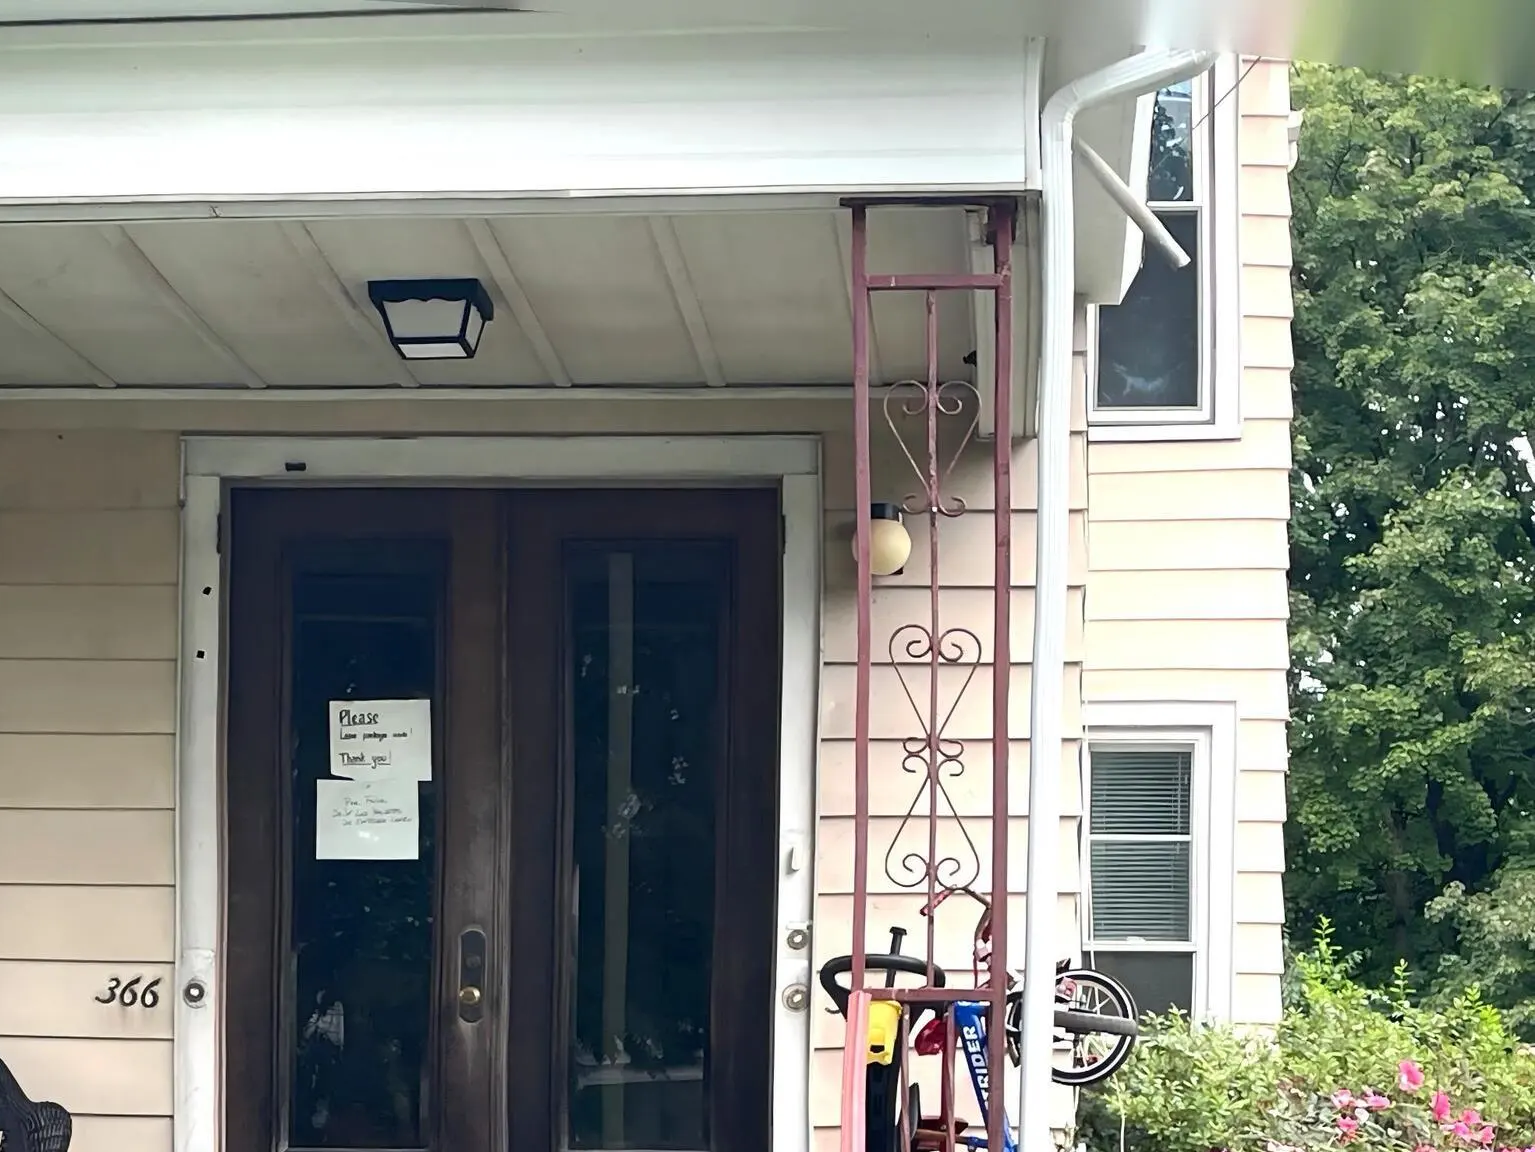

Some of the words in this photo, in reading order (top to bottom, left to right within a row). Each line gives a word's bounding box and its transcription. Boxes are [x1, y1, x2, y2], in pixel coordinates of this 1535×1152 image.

[339, 709, 379, 726] Please
[339, 752, 365, 763] Thank
[95, 976, 161, 1008] 366
[963, 1026, 989, 1110] TRIDER
